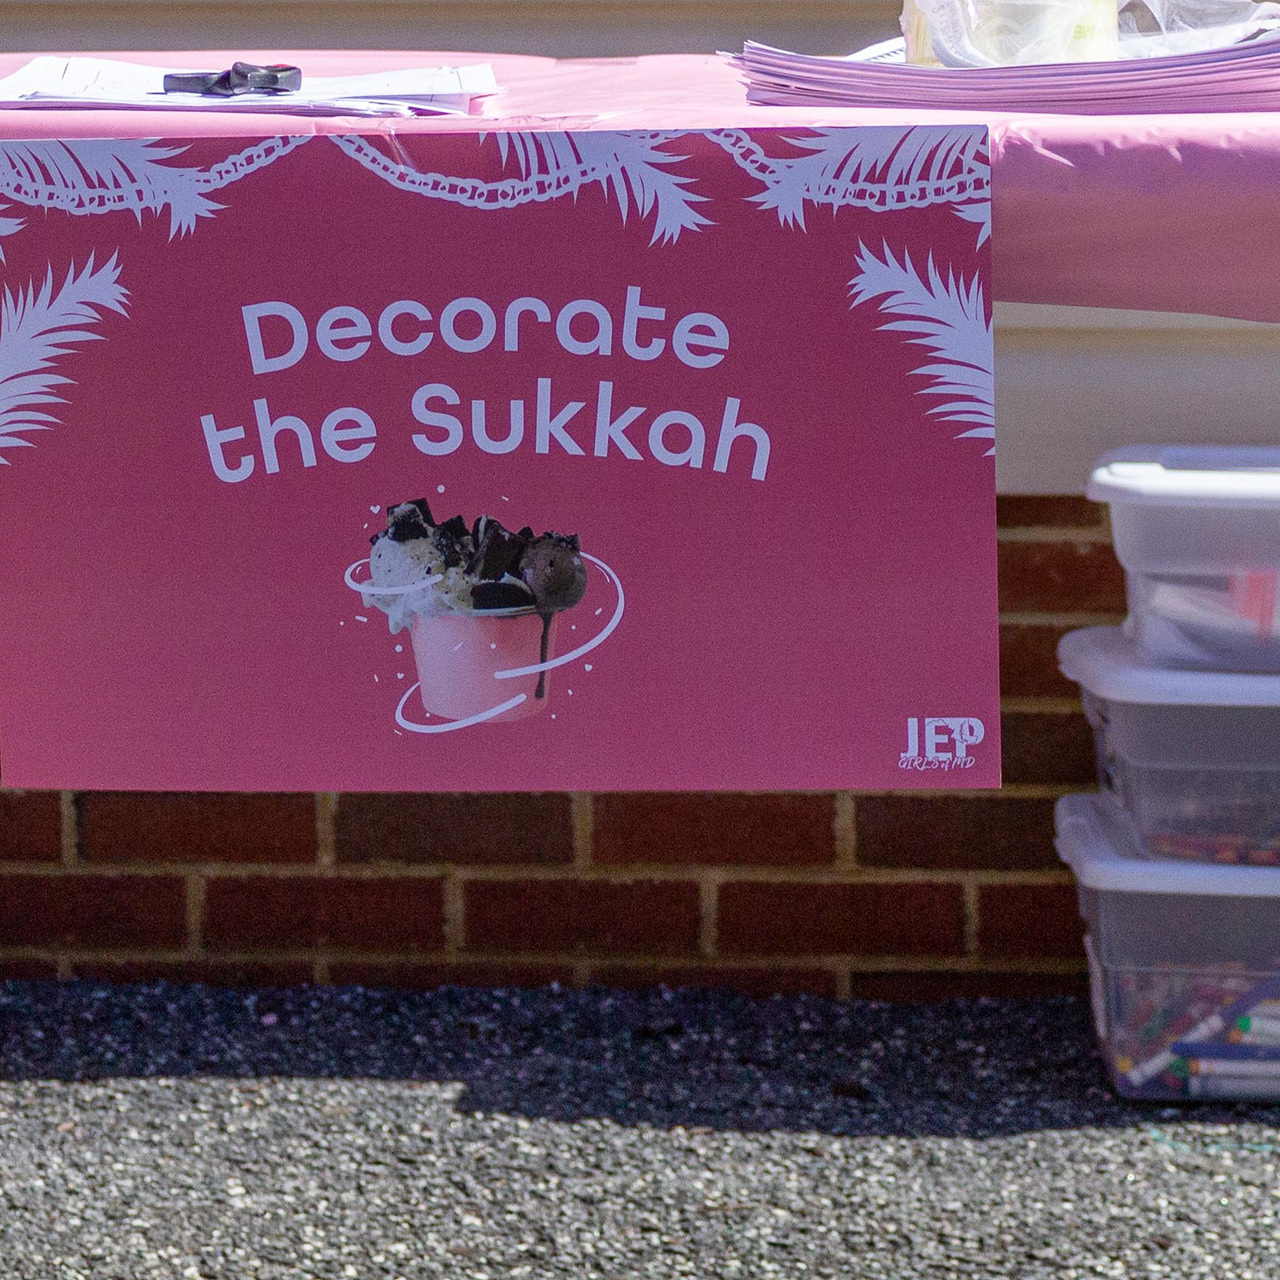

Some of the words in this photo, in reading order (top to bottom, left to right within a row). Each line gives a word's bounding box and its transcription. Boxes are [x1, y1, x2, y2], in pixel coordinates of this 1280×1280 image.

[242, 286, 729, 374] Decorate
[201, 399, 376, 483] the
[412, 378, 770, 480] Sukkah
[898, 756, 939, 771] GIRLS
[952, 756, 976, 770] MD
[900, 717, 985, 761] JEP
